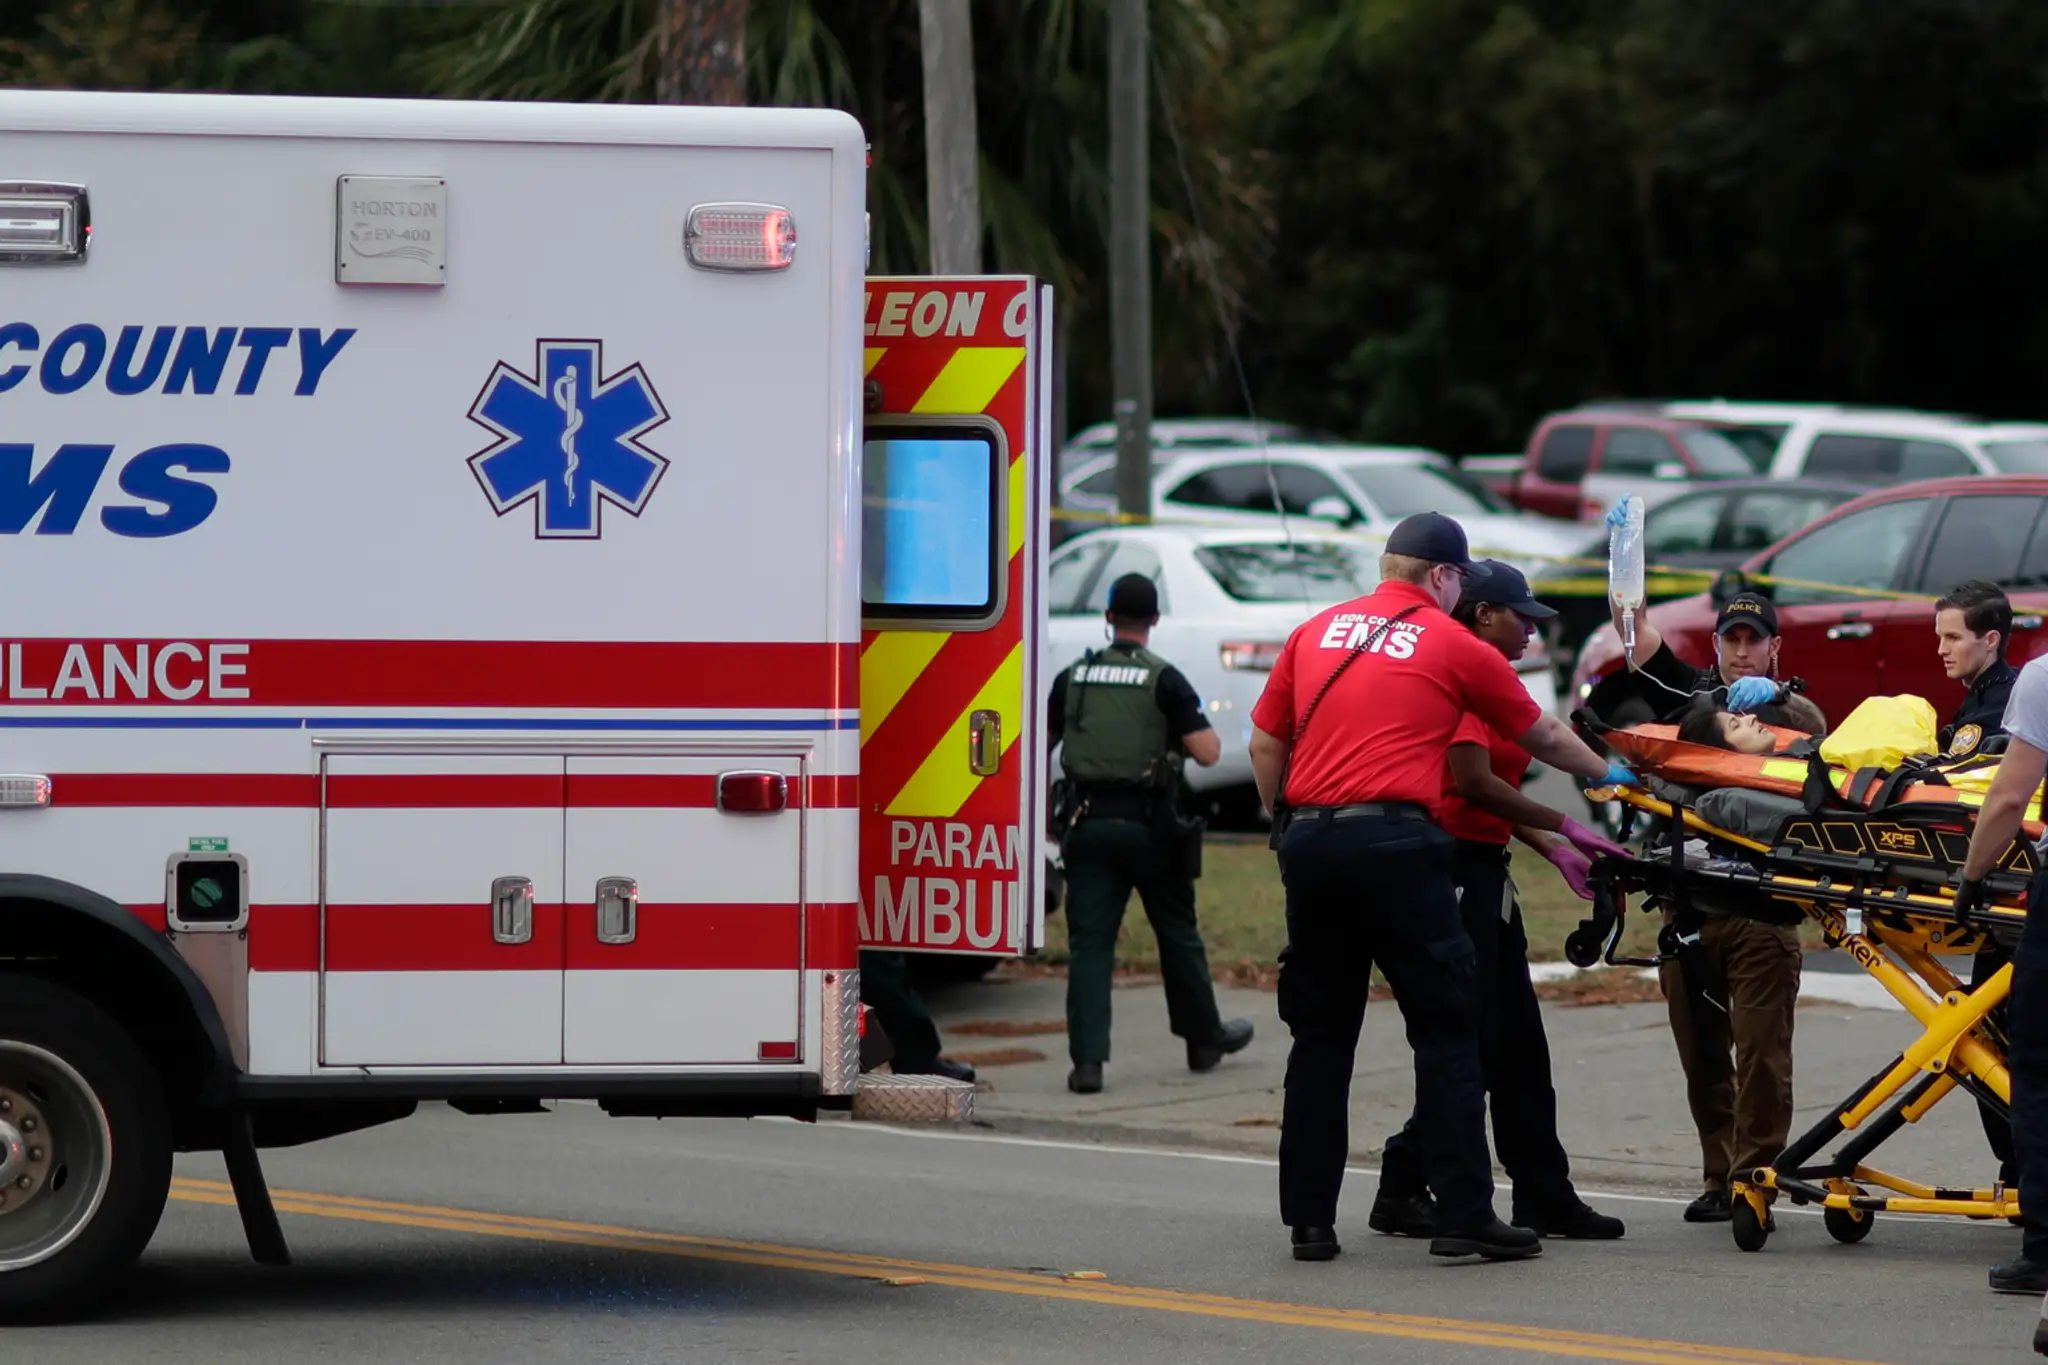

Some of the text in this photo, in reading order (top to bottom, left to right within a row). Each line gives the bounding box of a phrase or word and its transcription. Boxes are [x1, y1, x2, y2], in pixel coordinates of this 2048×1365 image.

[352, 201, 437, 217] HORTON
[0, 322, 358, 396] COUNTY
[0, 443, 230, 538] MS
[1332, 613, 1367, 623] LEON
[1726, 603, 1762, 615] POLICE
[1319, 622, 1419, 660] EMS
[0, 642, 251, 700] LANCE
[1075, 664, 1150, 685] SHERIFF
[1880, 831, 1916, 848] XPS
